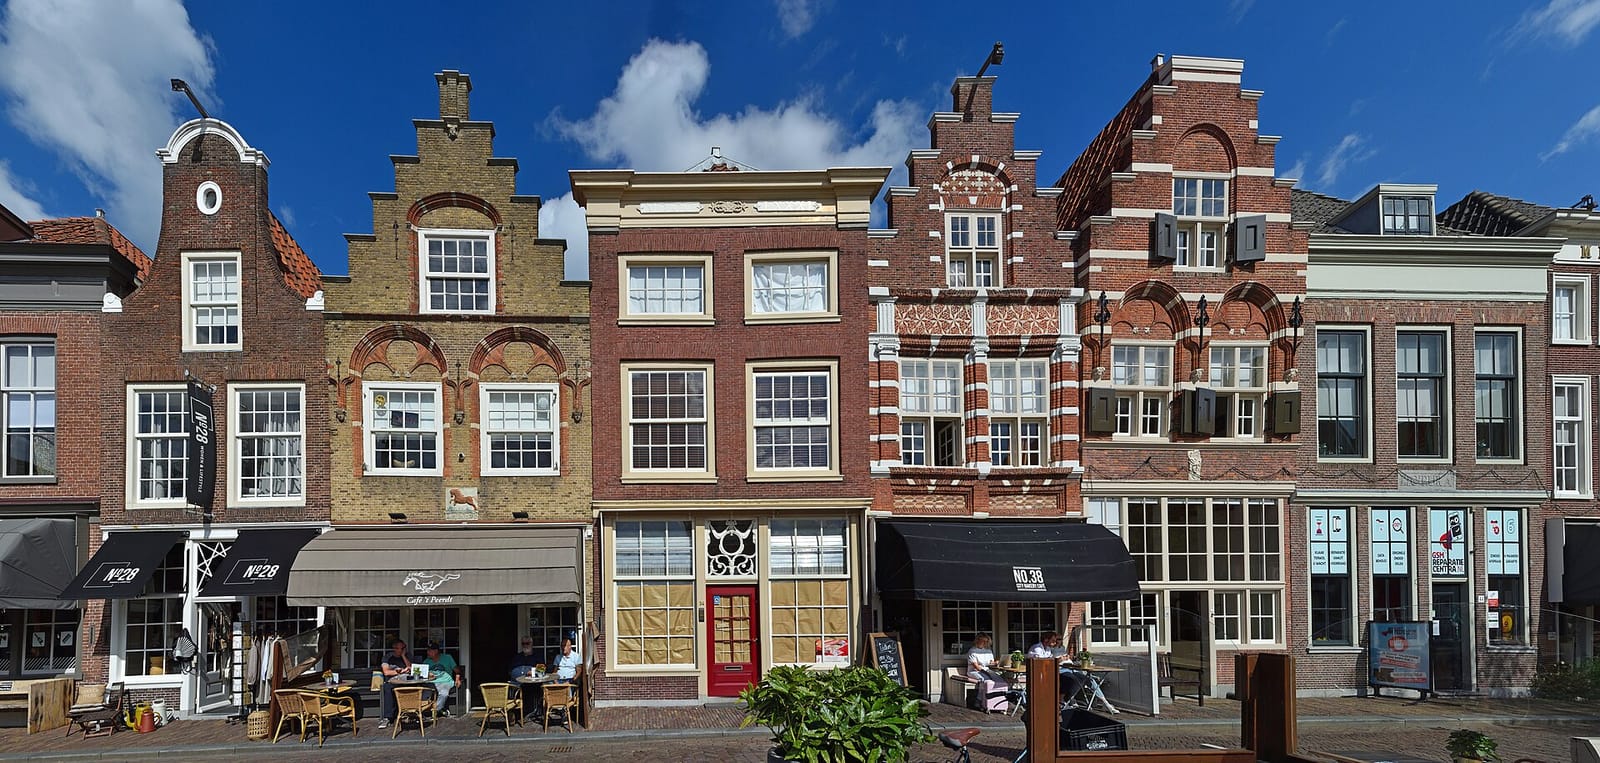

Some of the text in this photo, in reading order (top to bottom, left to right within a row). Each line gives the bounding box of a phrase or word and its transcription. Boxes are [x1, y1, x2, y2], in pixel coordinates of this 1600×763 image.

[1432, 551, 1444, 559] GSM
[1013, 569, 1044, 583] NO.38
[406, 596, 423, 606] Café
